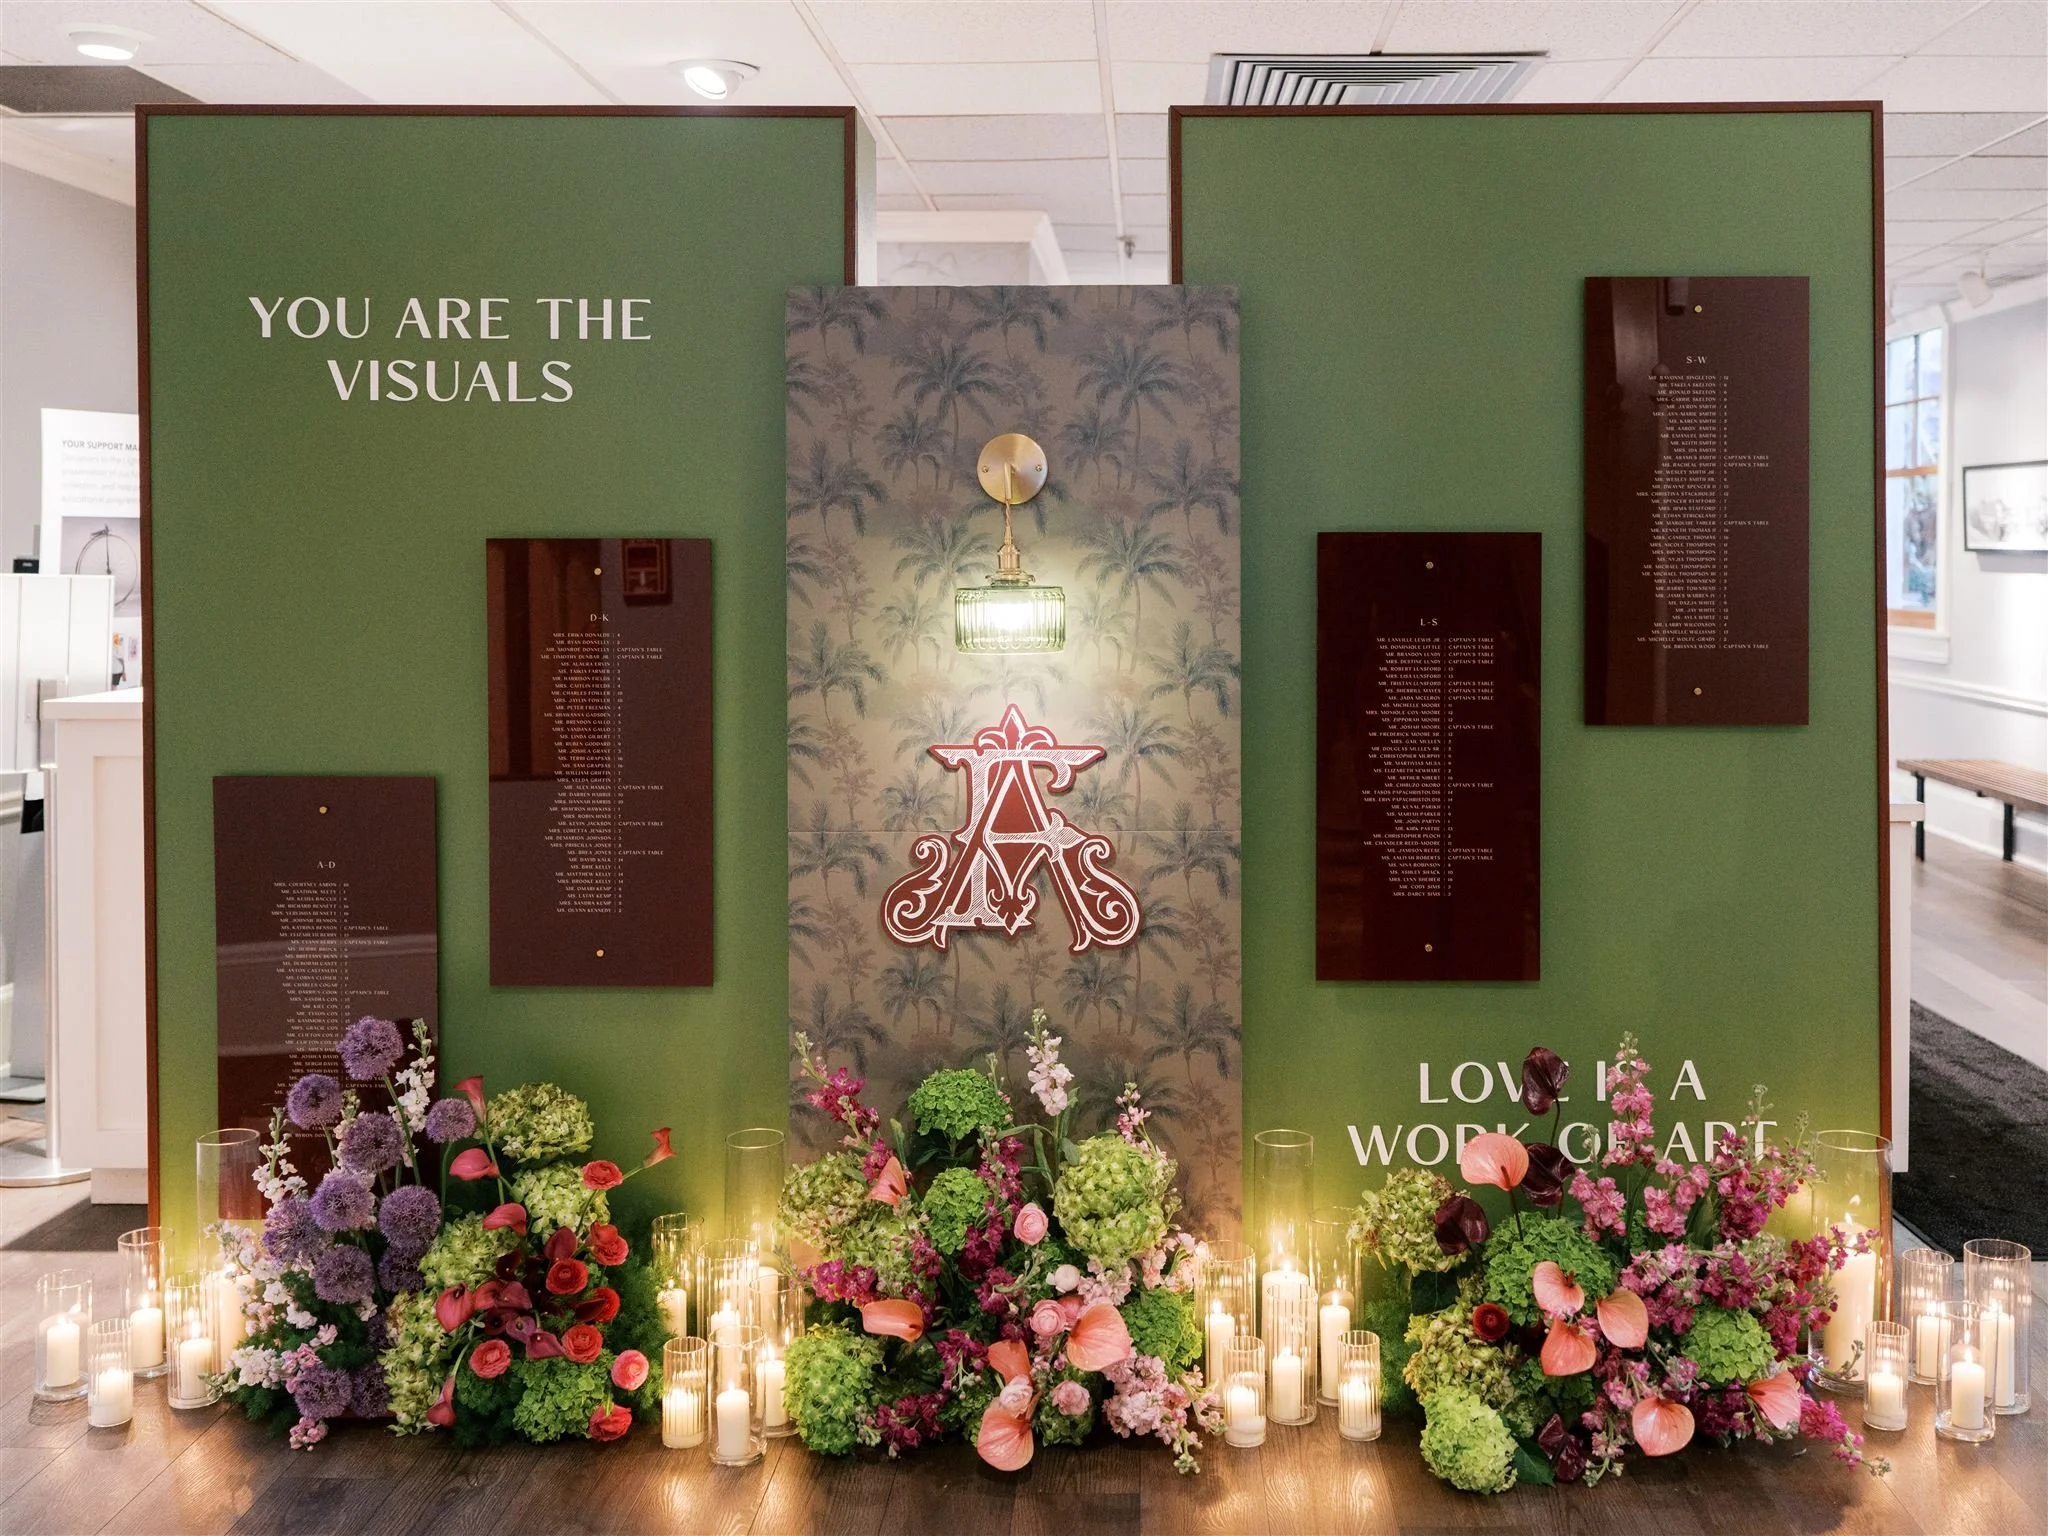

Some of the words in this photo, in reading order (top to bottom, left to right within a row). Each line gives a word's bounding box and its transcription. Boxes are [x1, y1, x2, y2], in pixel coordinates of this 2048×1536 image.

[249, 297, 370, 338] YOU
[395, 298, 510, 339] ARE
[536, 298, 651, 340] THE
[1686, 355, 1708, 364] S-W
[327, 359, 574, 402] VISUALS
[62, 440, 85, 448] YOUR
[87, 440, 123, 450] SUPPORT
[590, 613, 610, 622] D-K
[1420, 616, 1438, 626] L-S
[316, 860, 336, 869] A-D
[1420, 1061, 1570, 1104] LOV
[1670, 1060, 1707, 1101] A
[1663, 1121, 1778, 1164] ART
